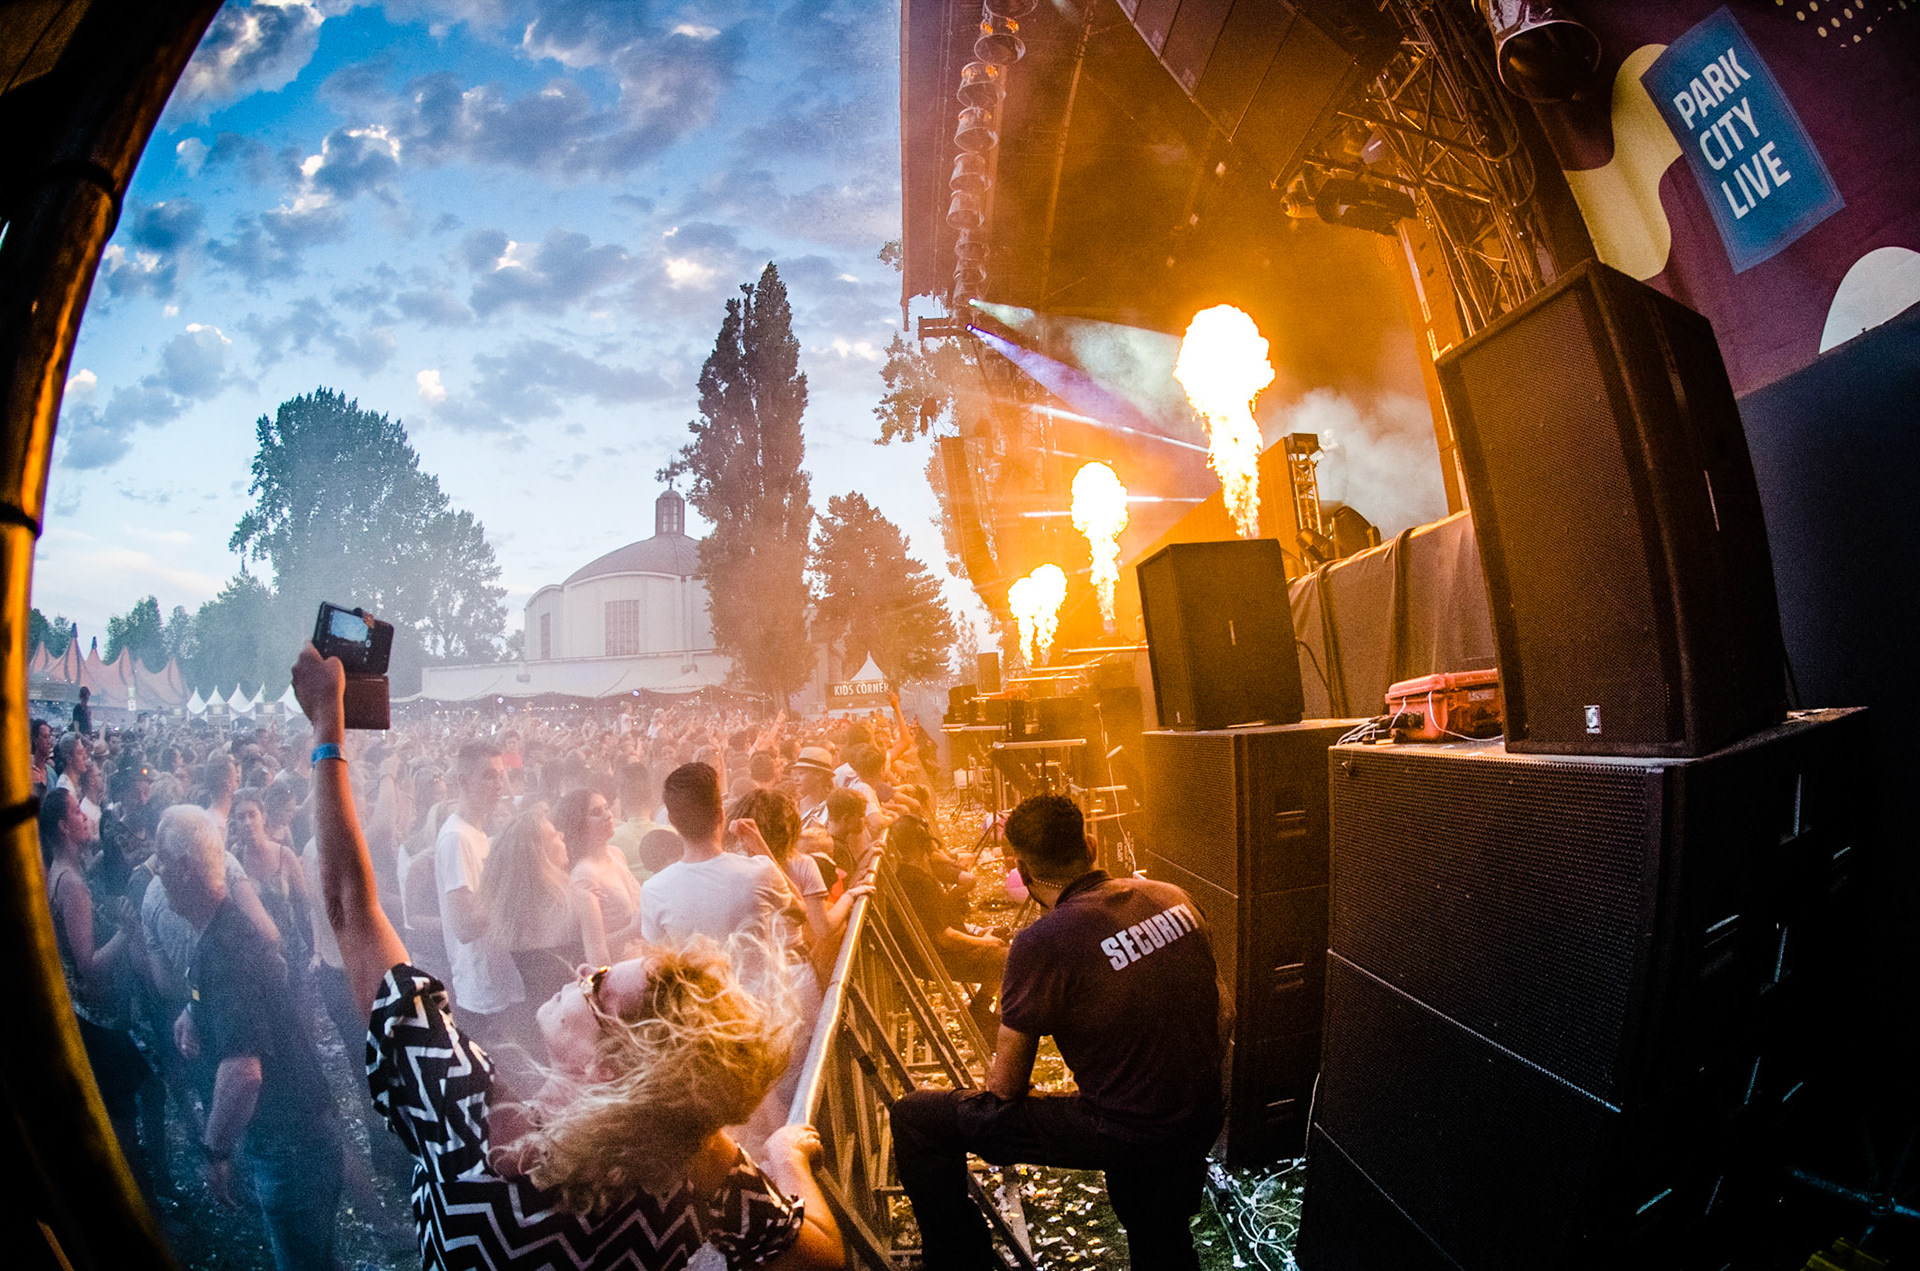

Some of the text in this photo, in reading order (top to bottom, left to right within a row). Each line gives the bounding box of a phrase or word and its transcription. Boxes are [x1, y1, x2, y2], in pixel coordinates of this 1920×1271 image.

[1673, 48, 1751, 130] PARK
[1700, 97, 1760, 171] CITY
[1721, 141, 1791, 220] LIVE
[834, 682, 889, 696] KIDS CORNER
[1100, 903, 1199, 971] SECURITY
